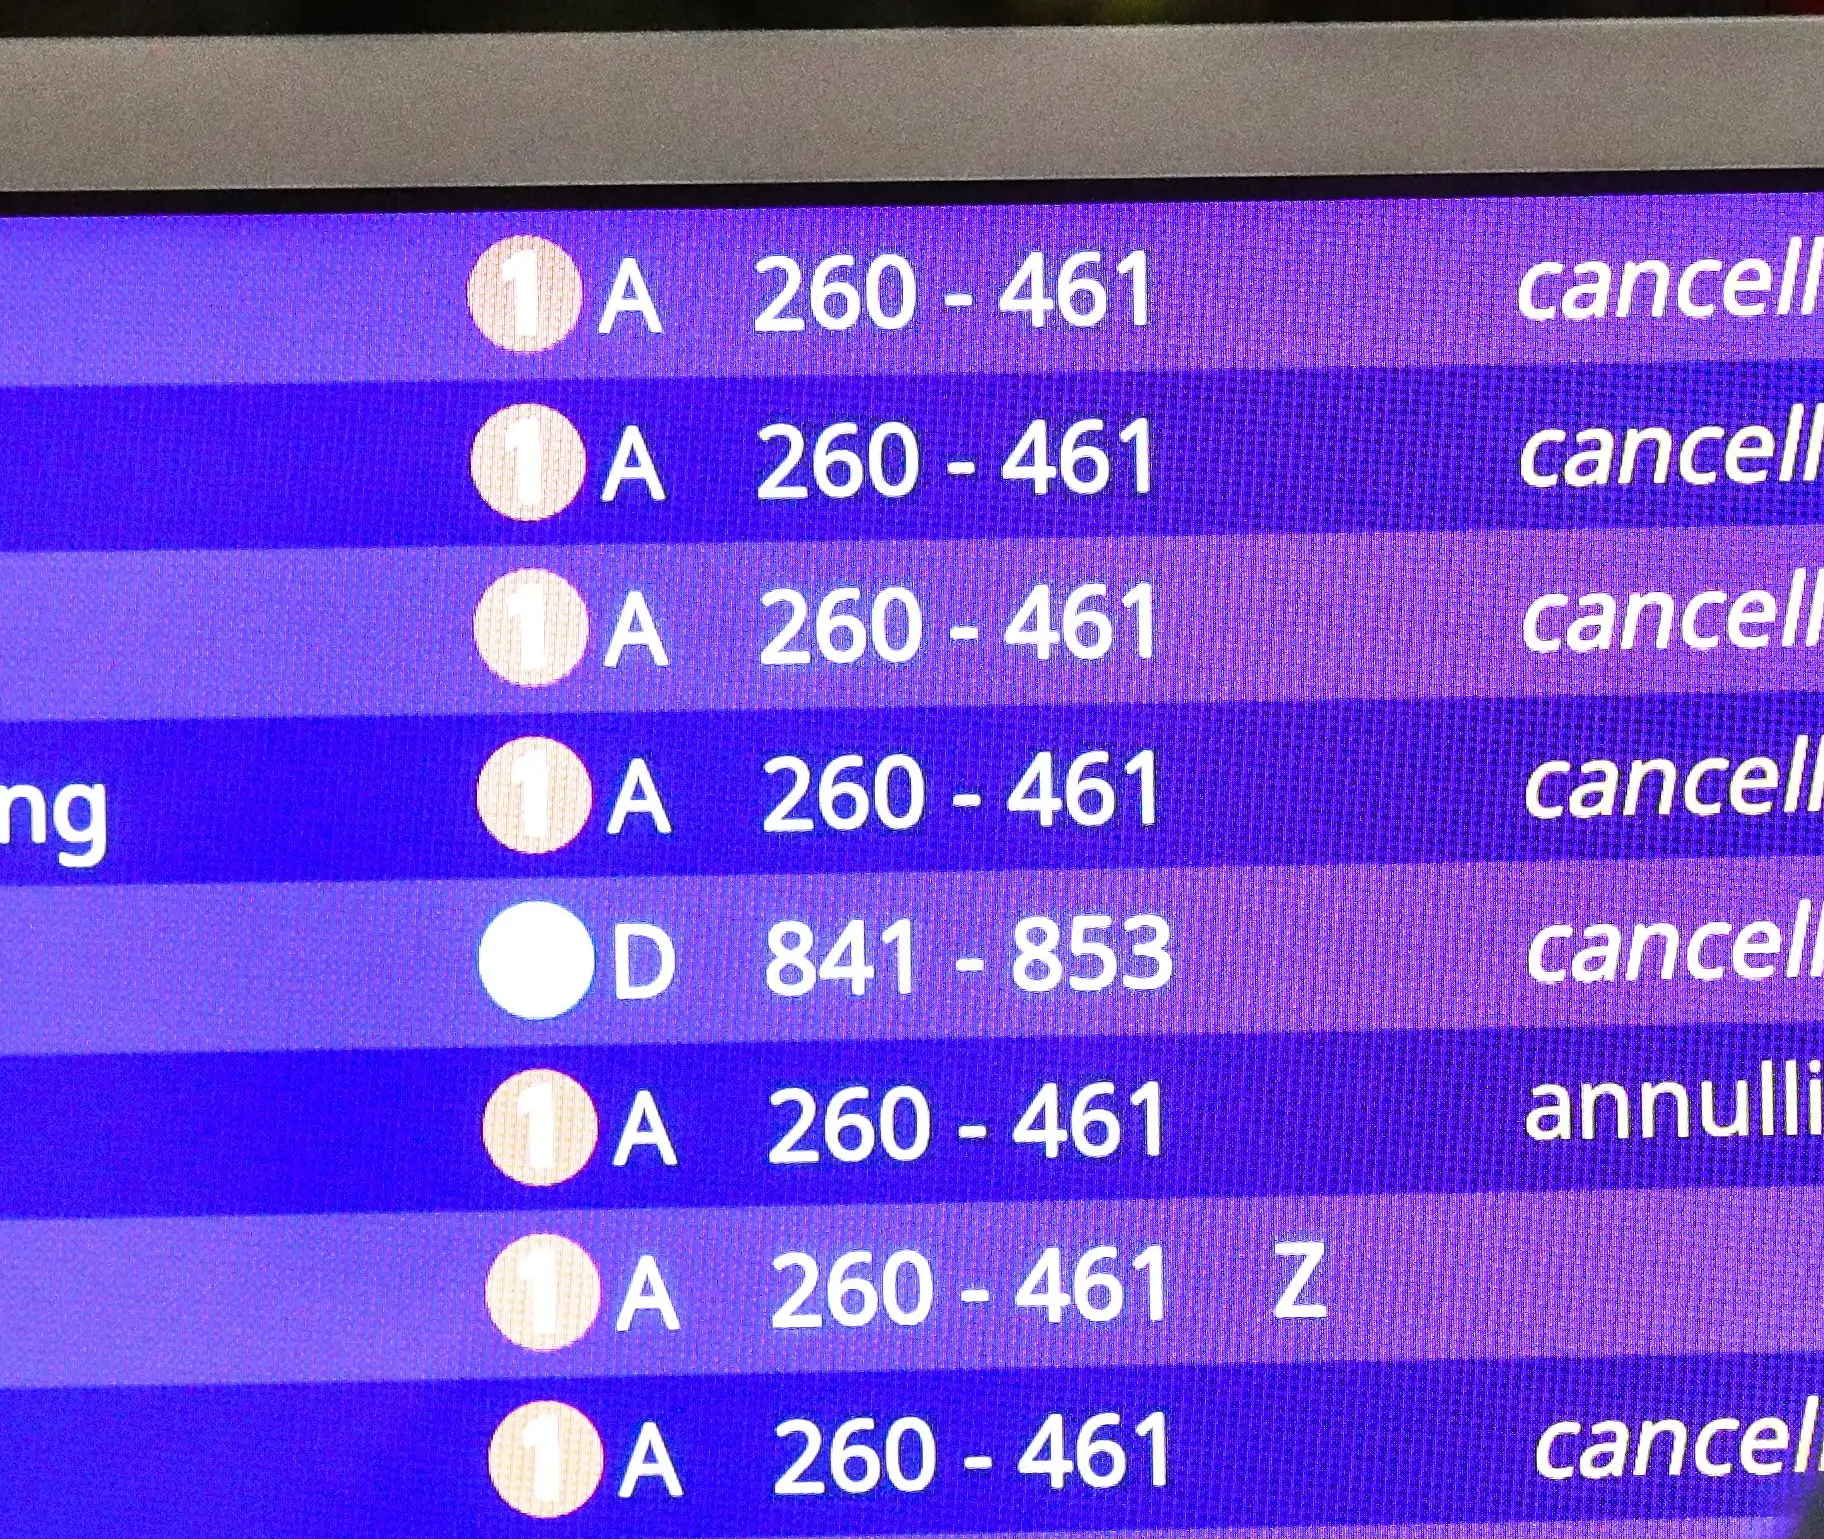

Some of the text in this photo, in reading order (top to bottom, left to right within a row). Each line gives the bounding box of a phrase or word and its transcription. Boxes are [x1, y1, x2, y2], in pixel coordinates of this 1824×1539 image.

[598, 256, 663, 334] A
[755, 254, 916, 331] 260
[1000, 251, 1150, 328] 461
[601, 424, 666, 502] A
[758, 422, 918, 500] 260
[1001, 418, 1151, 495] 461
[604, 591, 669, 668] A
[760, 586, 922, 665] 260
[1004, 582, 1154, 660] 461
[607, 758, 670, 833] A
[764, 754, 925, 832] 260
[1007, 750, 1156, 827] 461
[614, 922, 675, 999] D
[765, 917, 914, 997] 841
[1013, 914, 1173, 992] 853
[613, 1090, 677, 1166] A
[769, 1086, 931, 1164] 260
[1012, 1081, 1161, 1158] 461
[616, 1254, 680, 1330] A
[772, 1249, 933, 1328] 260
[1015, 1245, 1165, 1322] 461
[1273, 1240, 1328, 1319] Z
[619, 1421, 683, 1498] A
[774, 1416, 936, 1495] 260
[1018, 1412, 1167, 1489] 461
